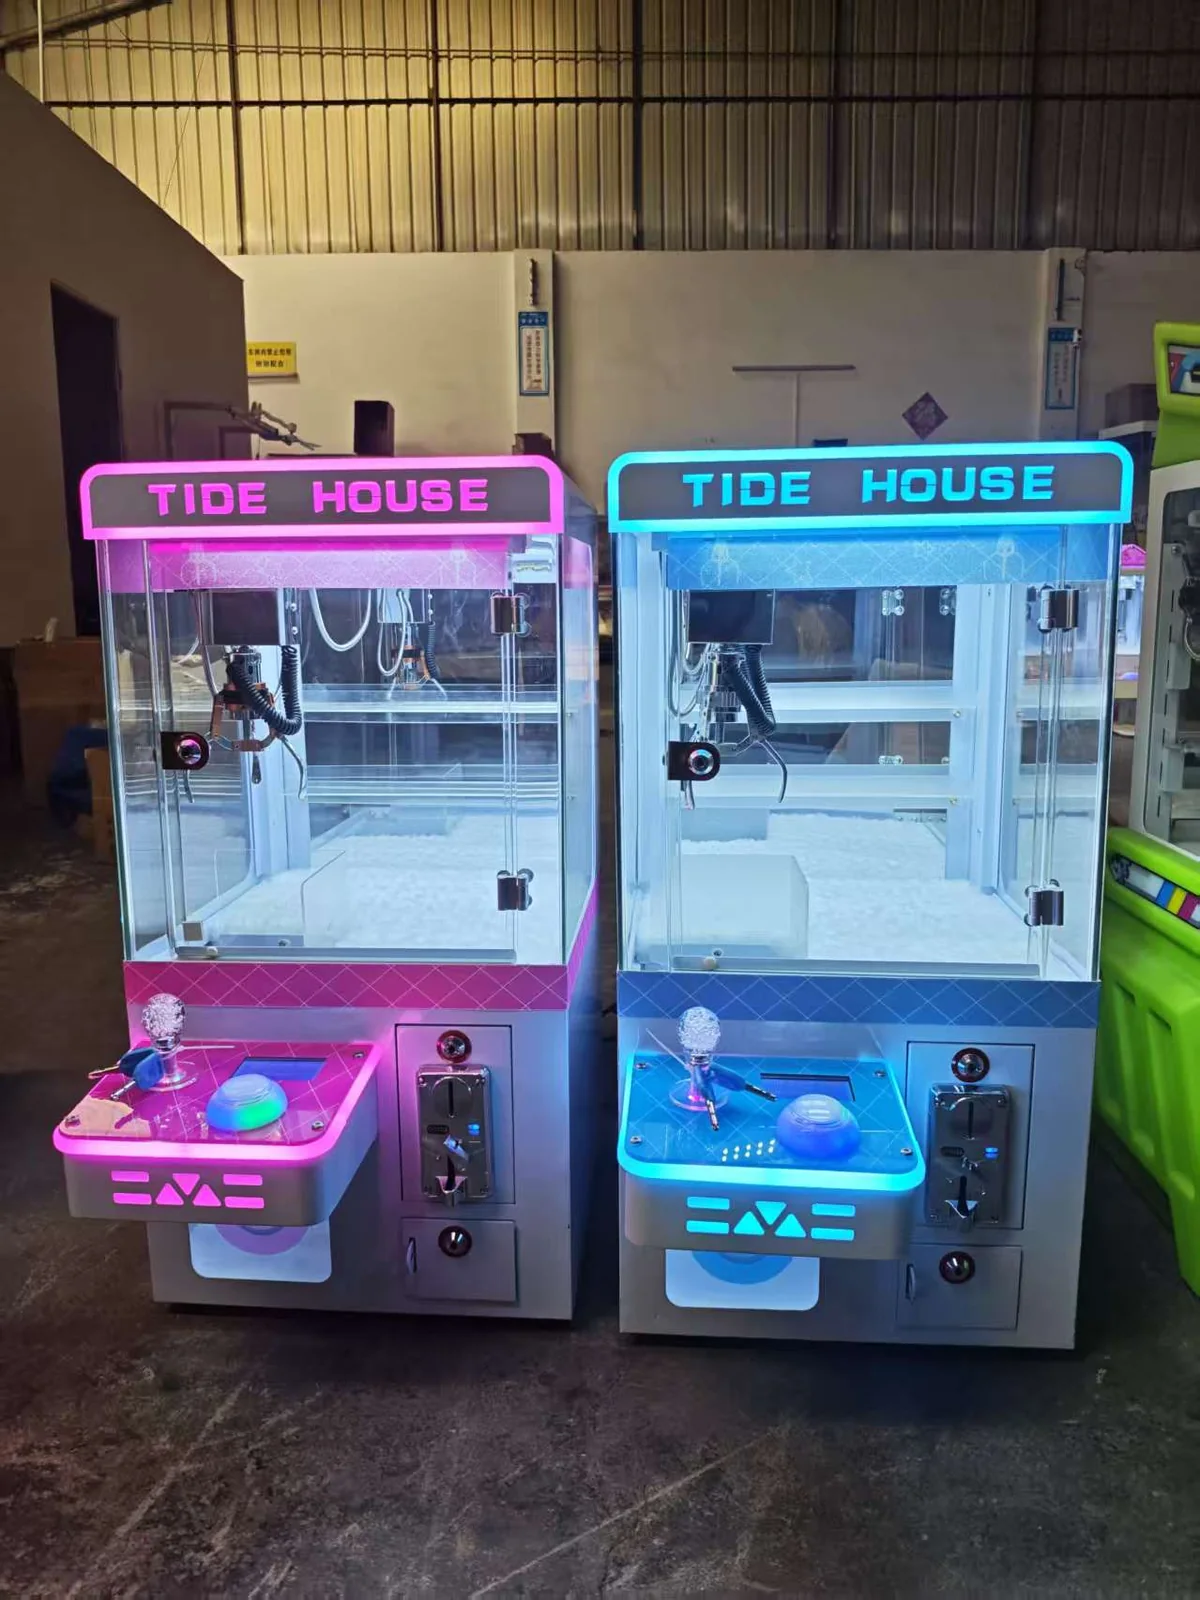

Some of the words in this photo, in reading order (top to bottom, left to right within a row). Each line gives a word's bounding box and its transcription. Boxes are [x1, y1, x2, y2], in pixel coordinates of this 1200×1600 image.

[147, 481, 268, 517] TIDE
[312, 478, 489, 513] HOUSE
[681, 470, 811, 509] TIDE
[860, 463, 1056, 505] HOUSE
